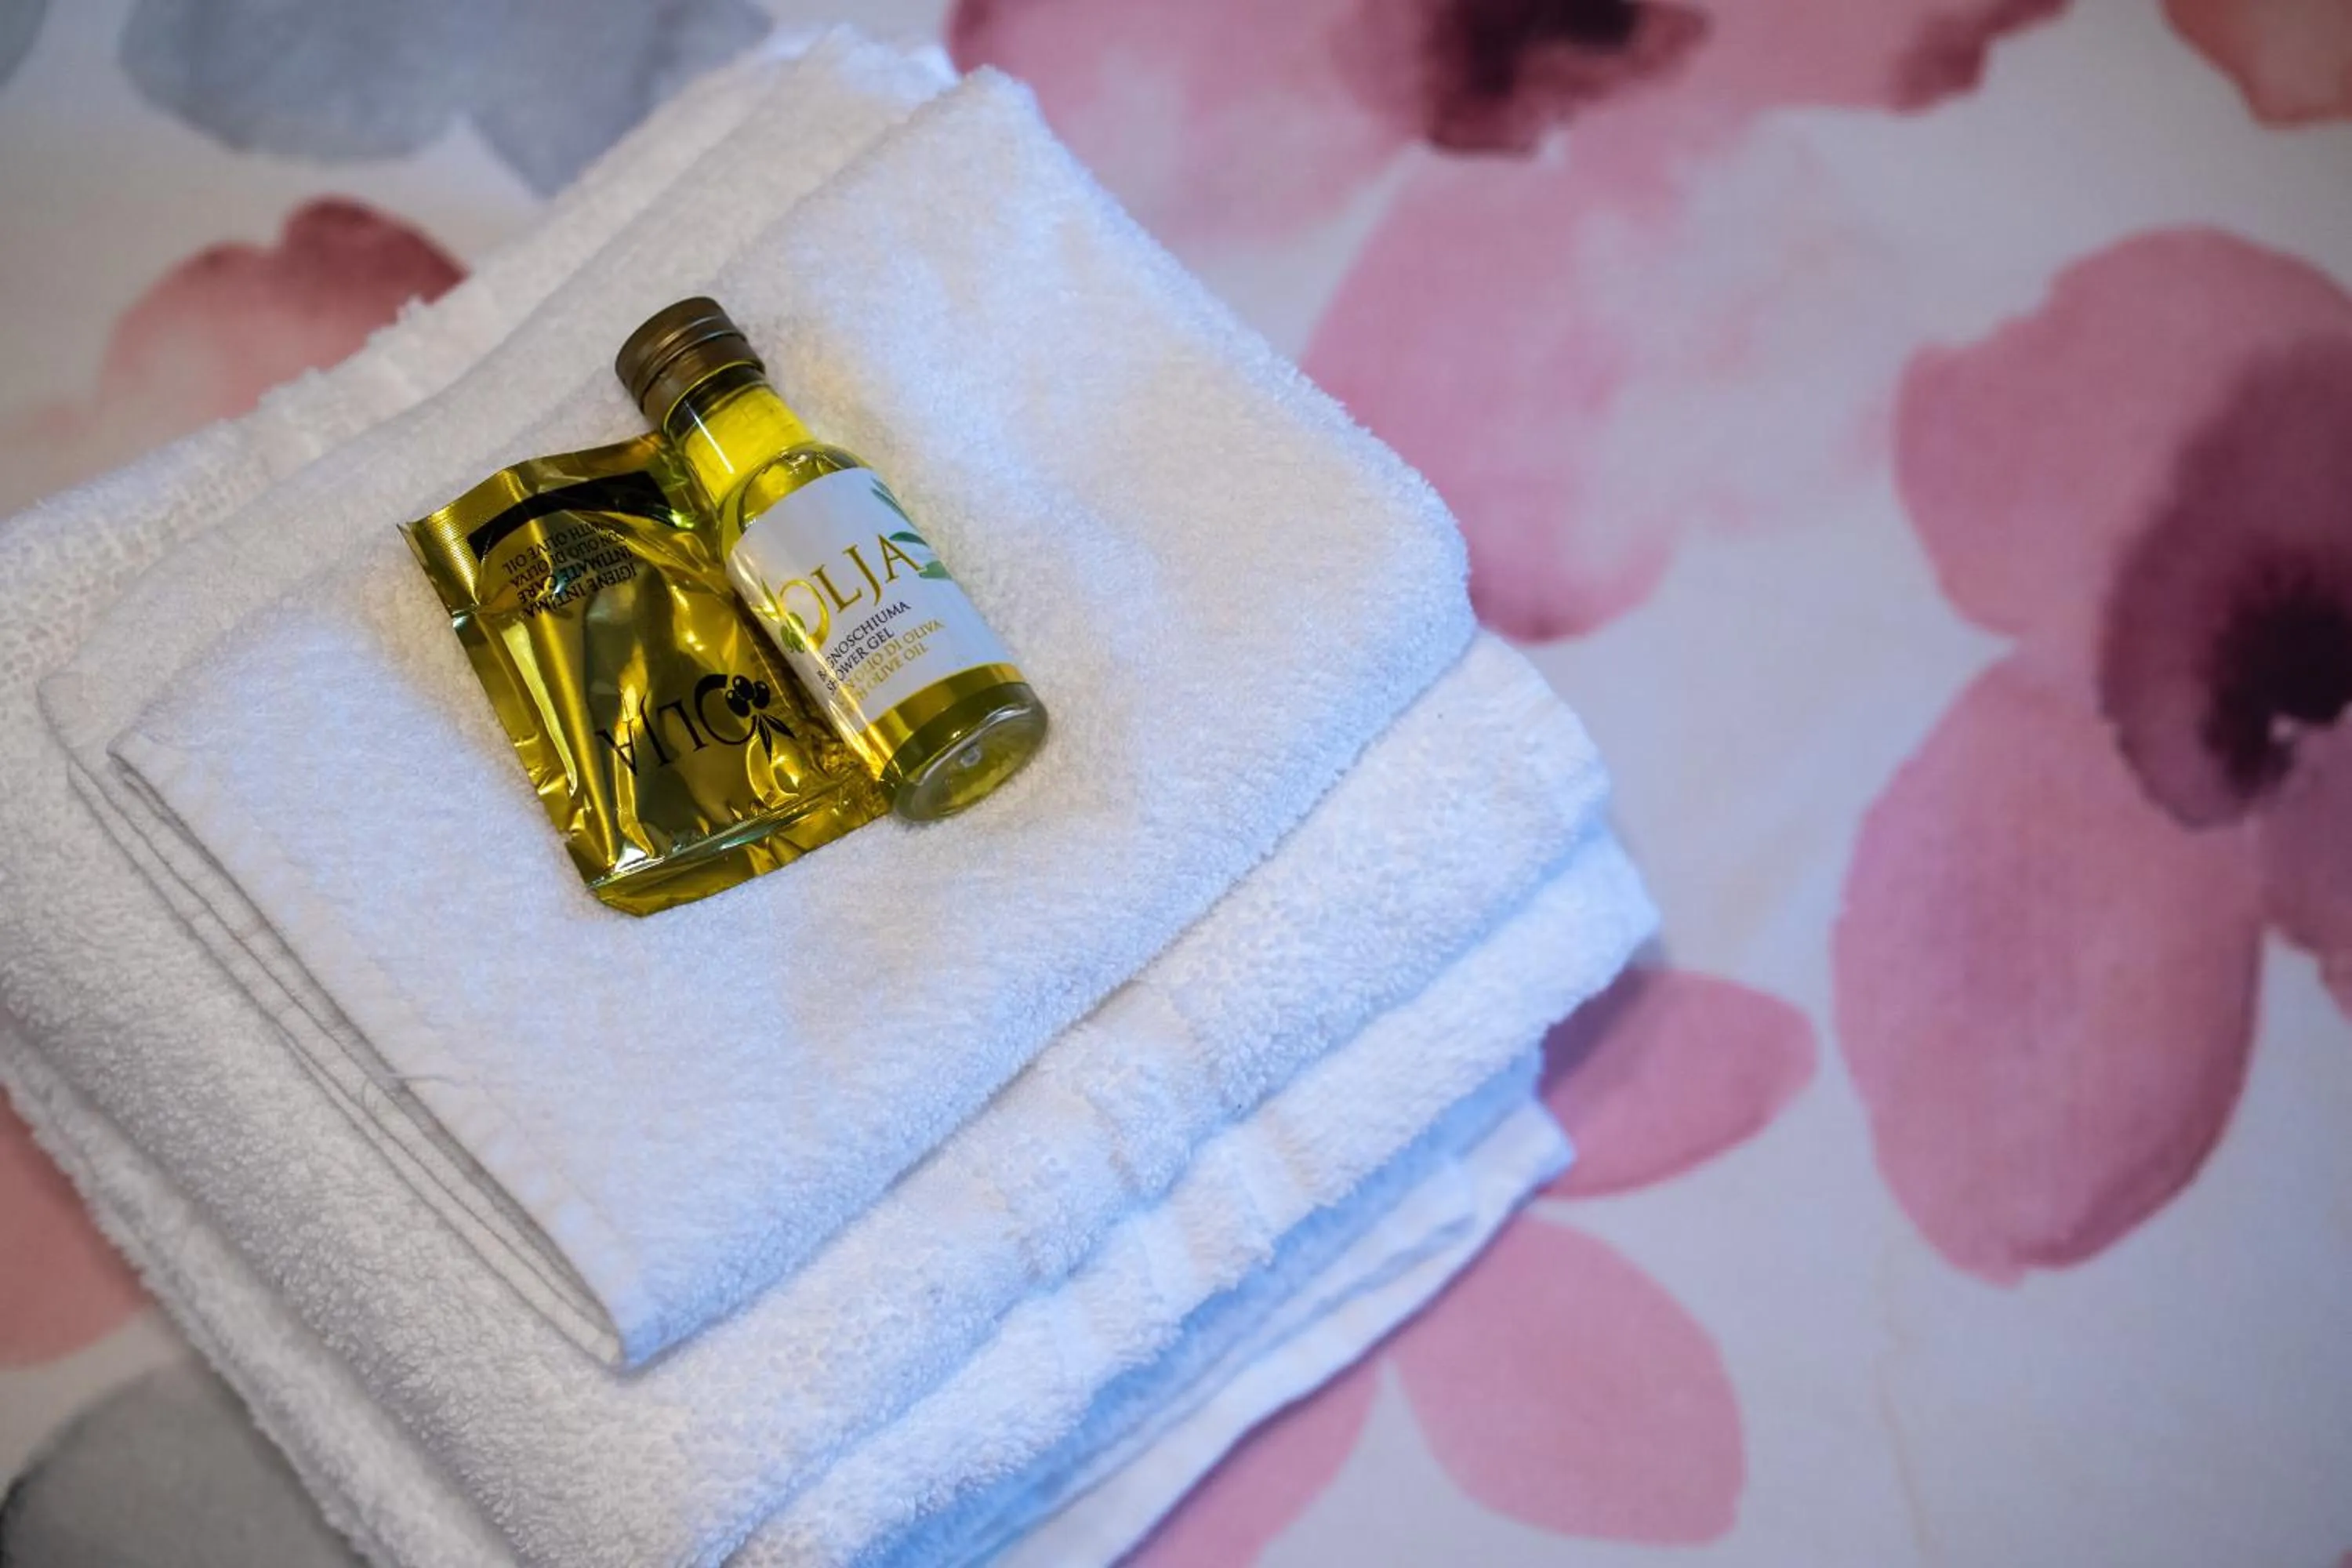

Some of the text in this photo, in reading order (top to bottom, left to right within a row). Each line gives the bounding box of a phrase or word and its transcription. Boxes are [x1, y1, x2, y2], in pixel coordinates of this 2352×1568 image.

[527, 531, 568, 556] OLIVE
[572, 538, 599, 557] OLIO
[503, 554, 527, 575] OIL
[553, 551, 567, 564] DI
[511, 561, 550, 588] OLIVA
[517, 546, 633, 604] INTIMATE CARE
[523, 563, 637, 619] IGIENE INTIMA
[779, 534, 923, 651] OLJA
[817, 601, 912, 682] BGNOSCHIUMA
[866, 627, 895, 649] GEL
[884, 639, 902, 657] DI
[903, 619, 946, 644] OLIVA
[903, 642, 929, 662] OIL
[595, 673, 759, 777] OLJA
